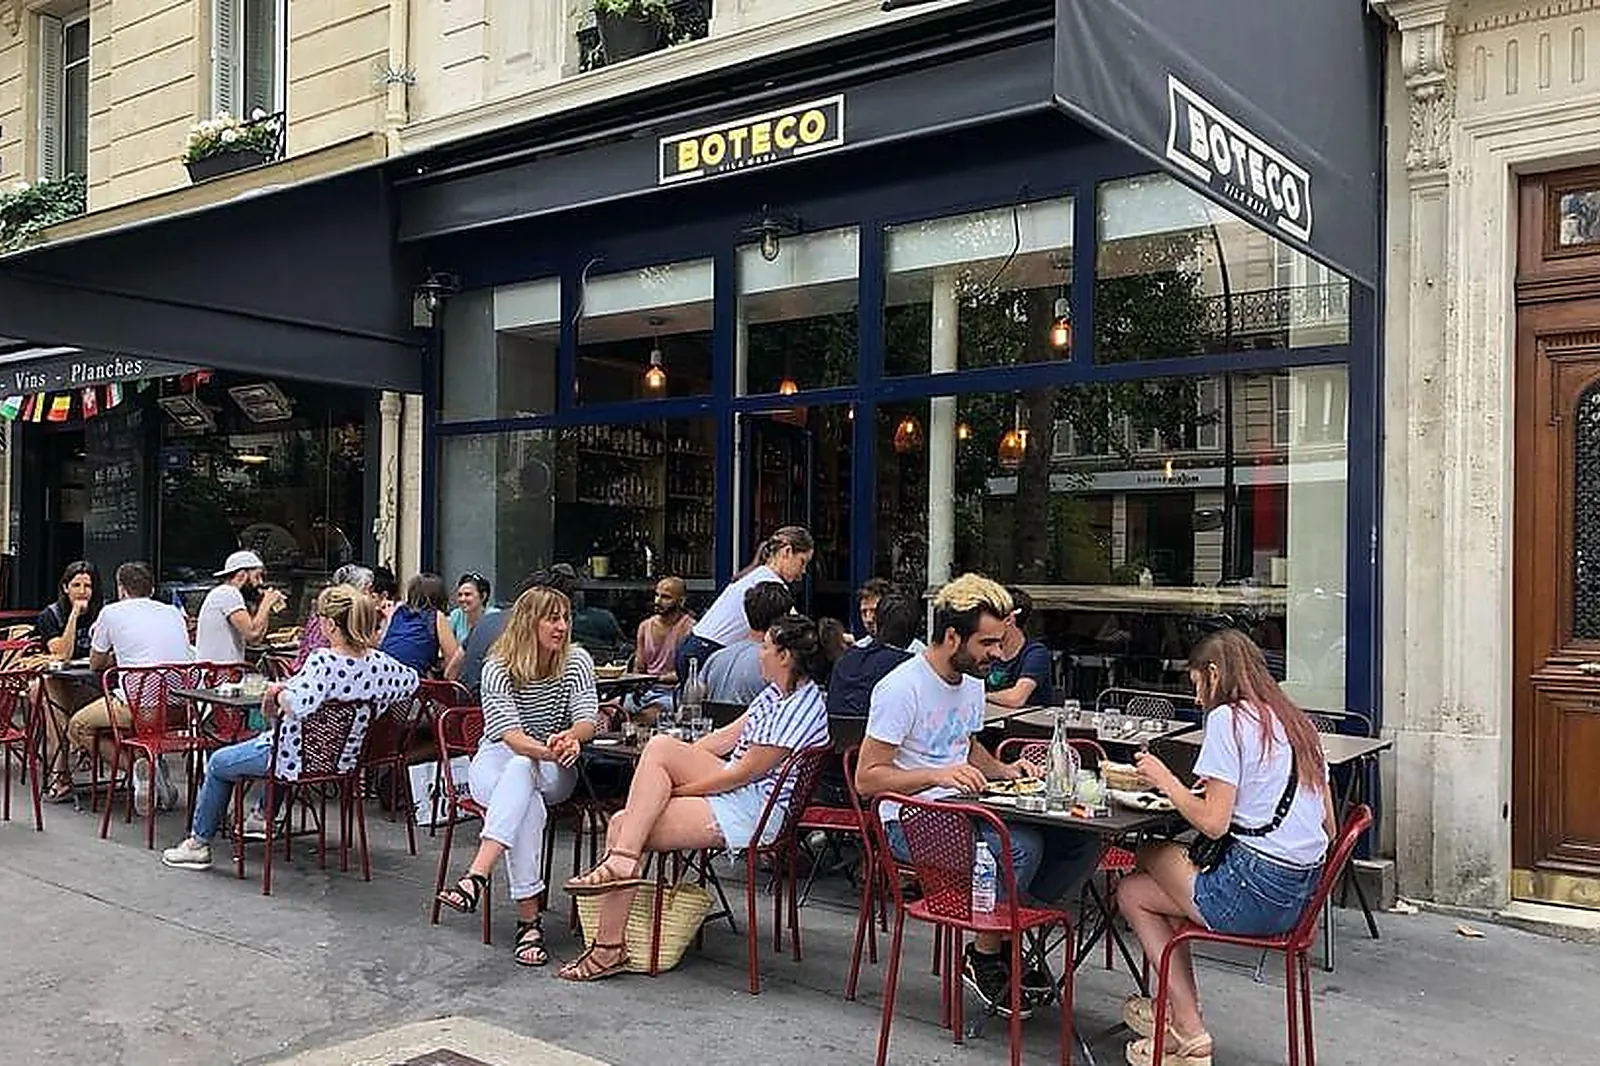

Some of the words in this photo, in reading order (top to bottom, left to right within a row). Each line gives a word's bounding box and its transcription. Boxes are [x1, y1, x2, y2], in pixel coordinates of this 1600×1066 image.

[678, 110, 826, 171] BOTECO
[1188, 104, 1300, 220] BOTECO
[15, 371, 46, 389] Vins
[72, 358, 142, 382] Planches
